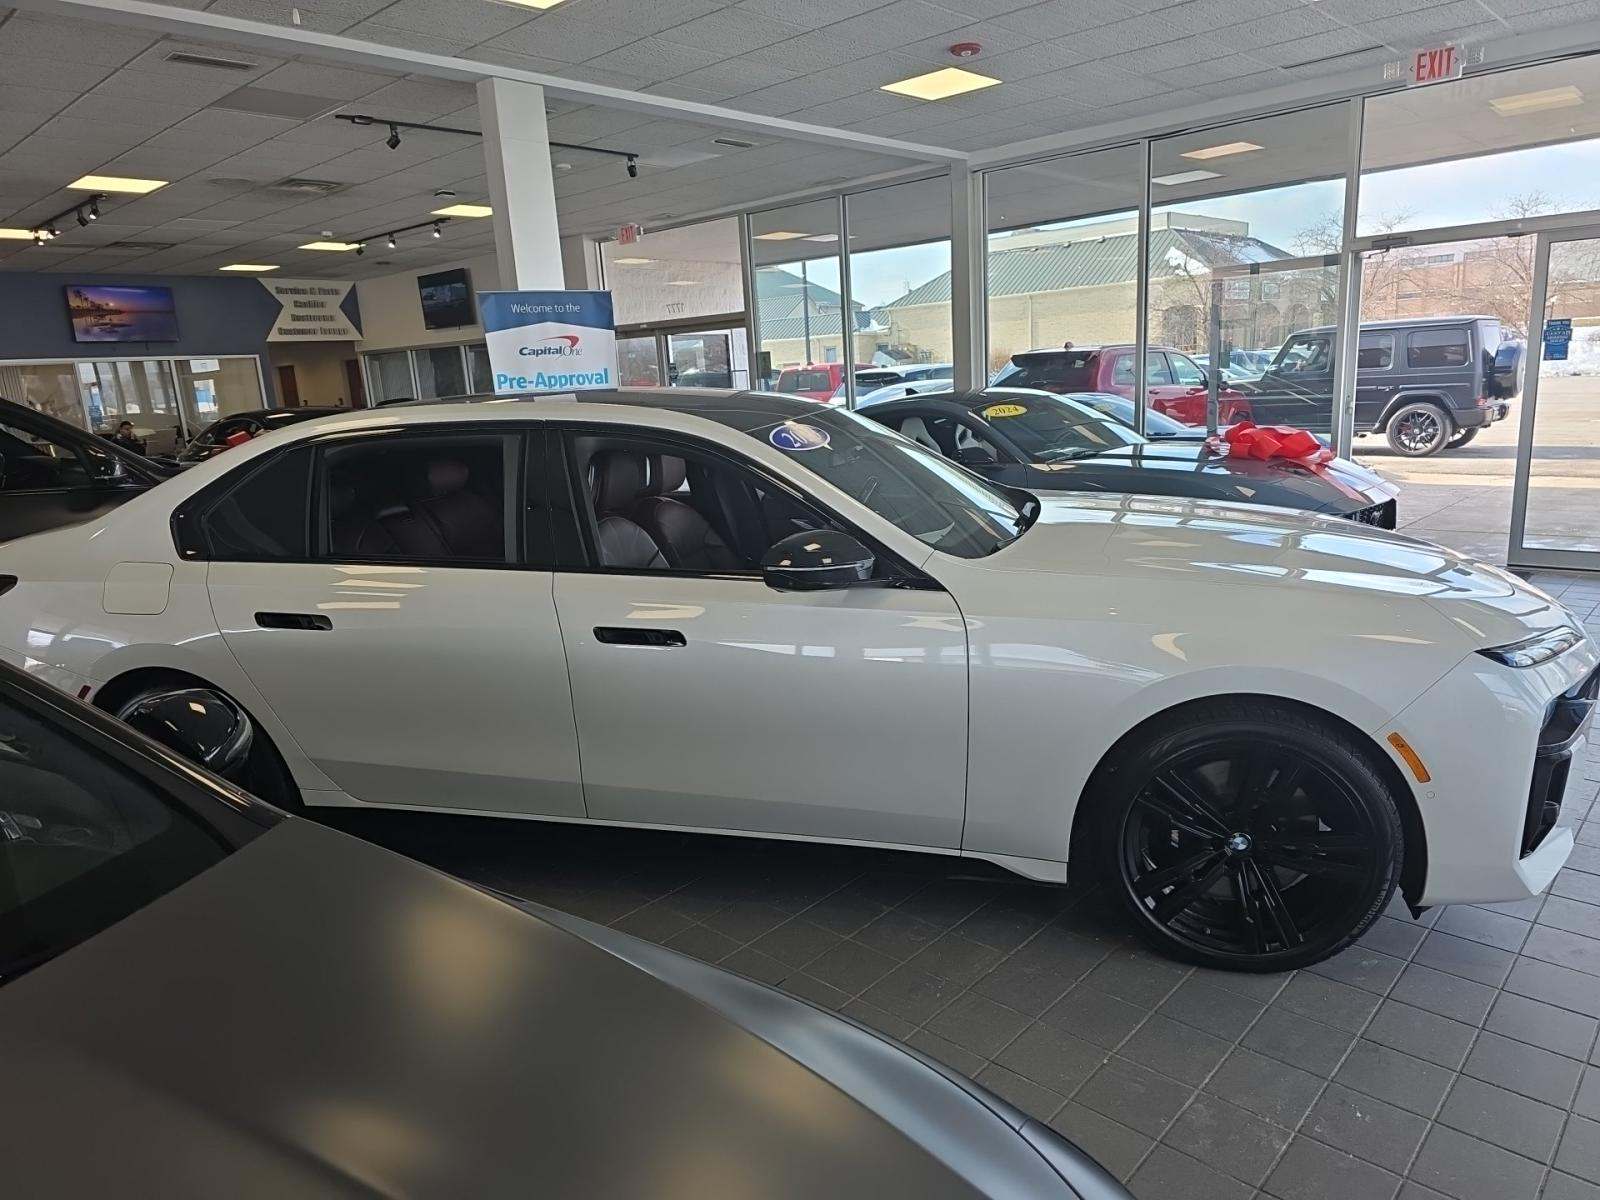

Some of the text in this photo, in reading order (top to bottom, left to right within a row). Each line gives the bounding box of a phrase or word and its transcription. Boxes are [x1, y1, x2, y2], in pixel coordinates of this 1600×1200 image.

[1415, 47, 1456, 82] EXIT
[620, 226, 636, 243] EXIT
[511, 303, 581, 314] Welcome to the
[496, 368, 609, 390] Pre-Approval
[992, 406, 1019, 416] 2024
